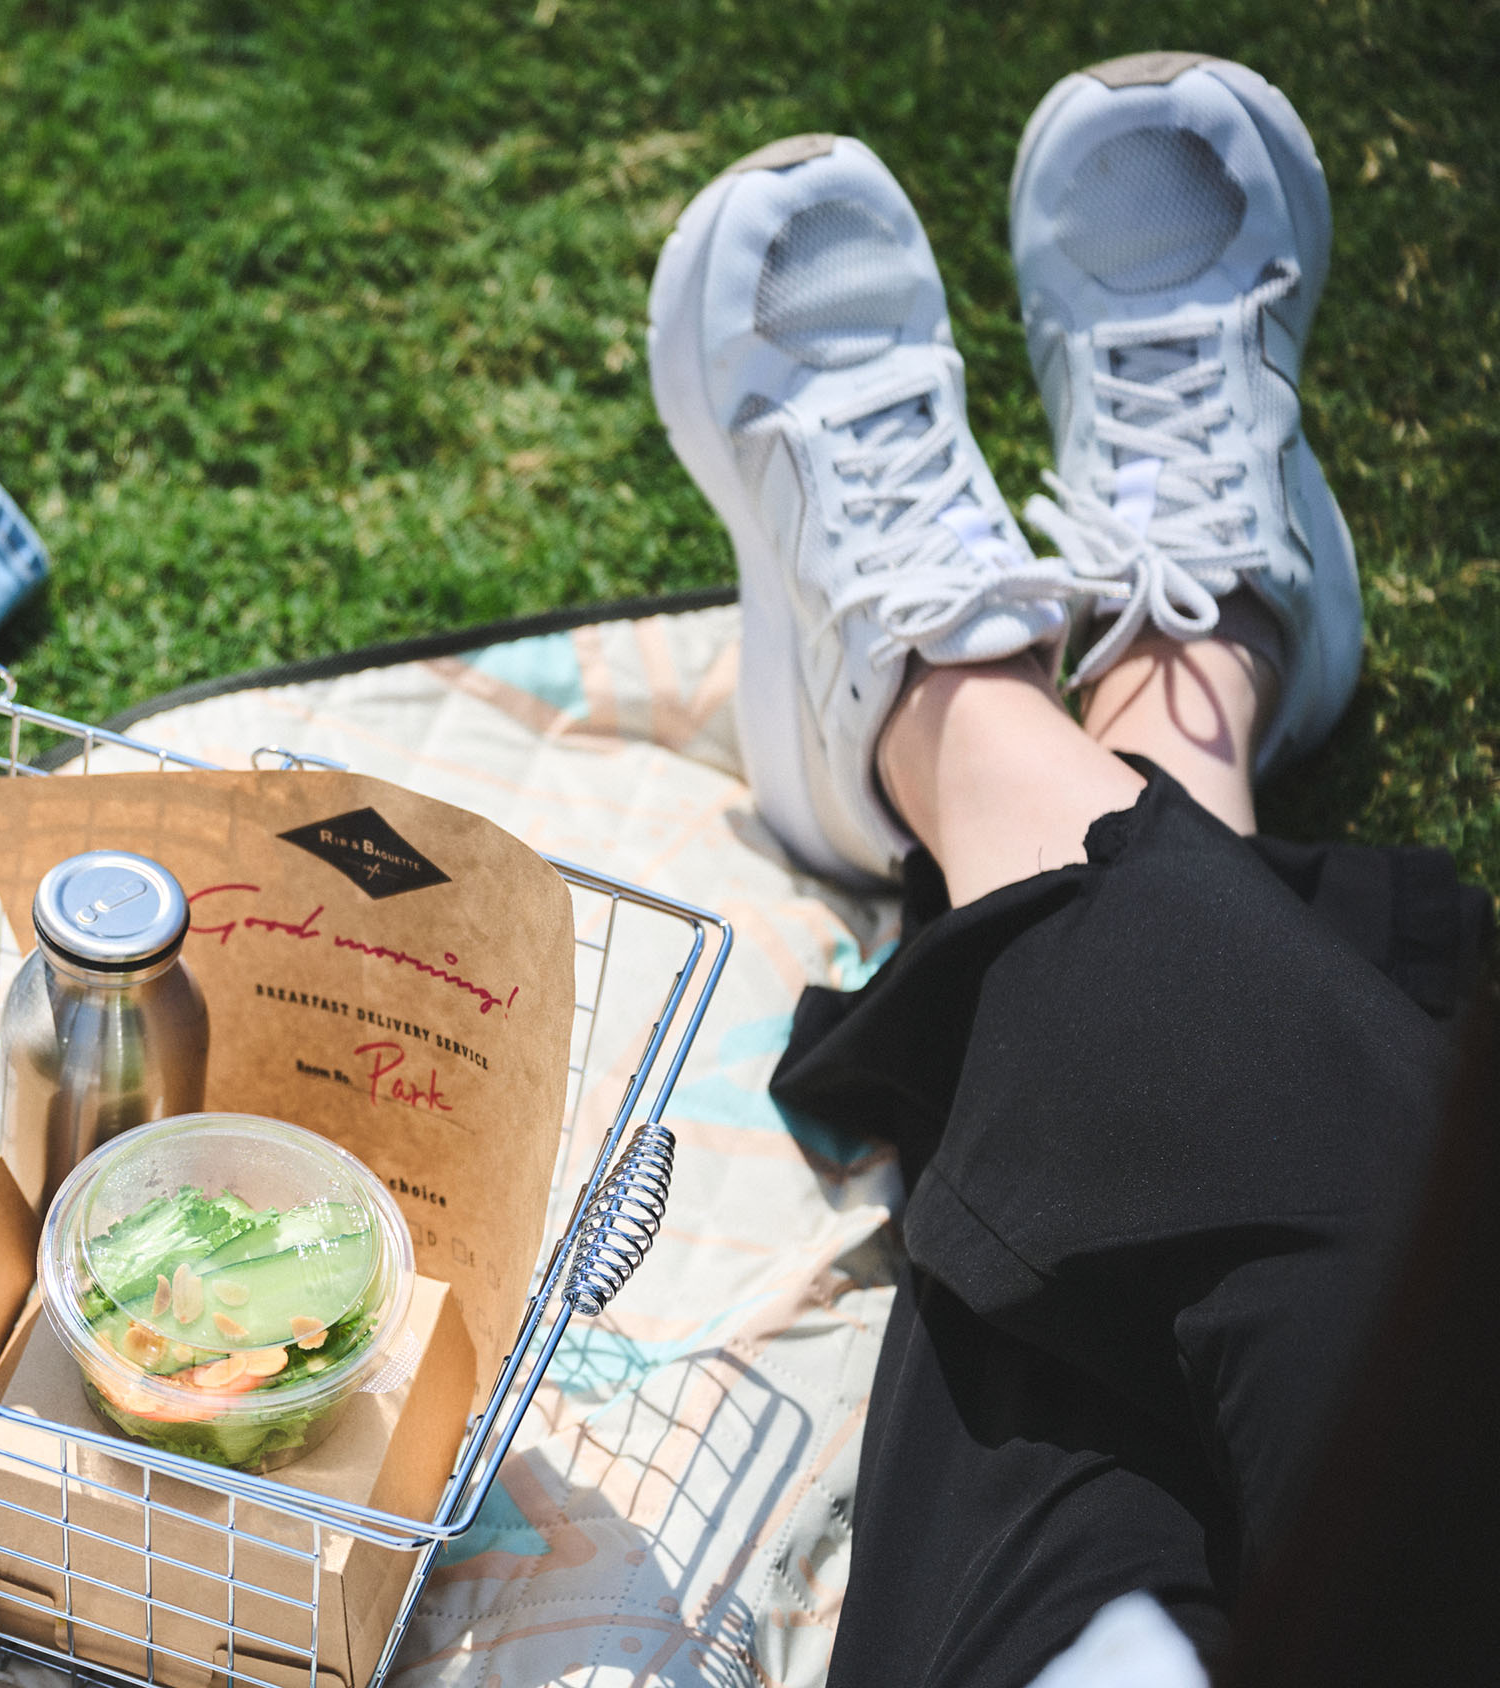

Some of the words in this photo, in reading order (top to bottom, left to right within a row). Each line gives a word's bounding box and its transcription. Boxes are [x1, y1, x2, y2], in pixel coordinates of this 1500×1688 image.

[362, 839, 421, 872] BAGUETTE
[255, 982, 350, 1017] BREAKFAST
[356, 1006, 430, 1043] DELIVERY
[436, 1033, 489, 1071] SERVICE
[354, 1041, 453, 1112] Park
[388, 1177, 447, 1208] choice
